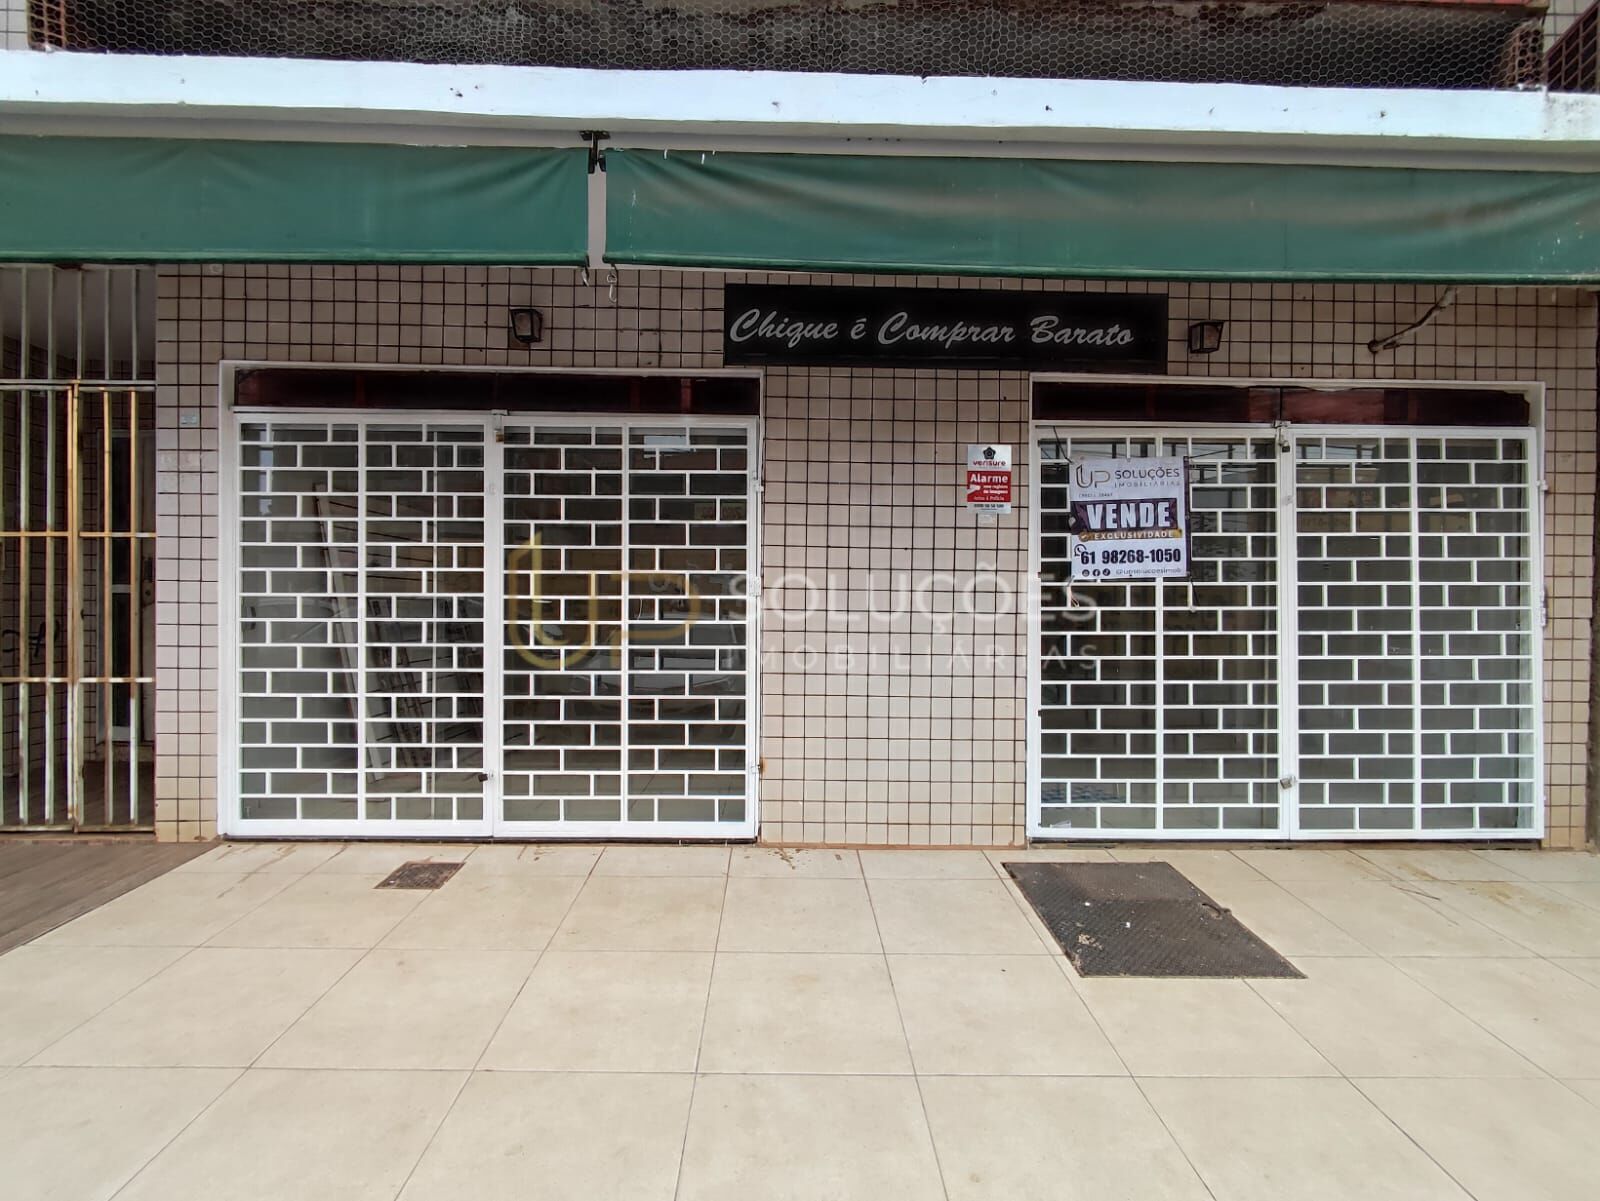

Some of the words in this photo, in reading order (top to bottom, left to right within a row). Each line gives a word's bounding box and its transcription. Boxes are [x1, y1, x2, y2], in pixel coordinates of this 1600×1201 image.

[729, 308, 839, 350] Chique
[850, 317, 867, 342] é
[877, 311, 1016, 350] Comprar
[1029, 315, 1134, 346] Barato
[970, 473, 1008, 483] Alarme
[1114, 466, 1180, 481] SOLUÇÕES
[1086, 502, 1171, 530] VENDE
[1094, 530, 1174, 540] EXCLUSIVIDADE
[1080, 551, 1096, 565] 61
[1102, 548, 1181, 565] 98268-1050
